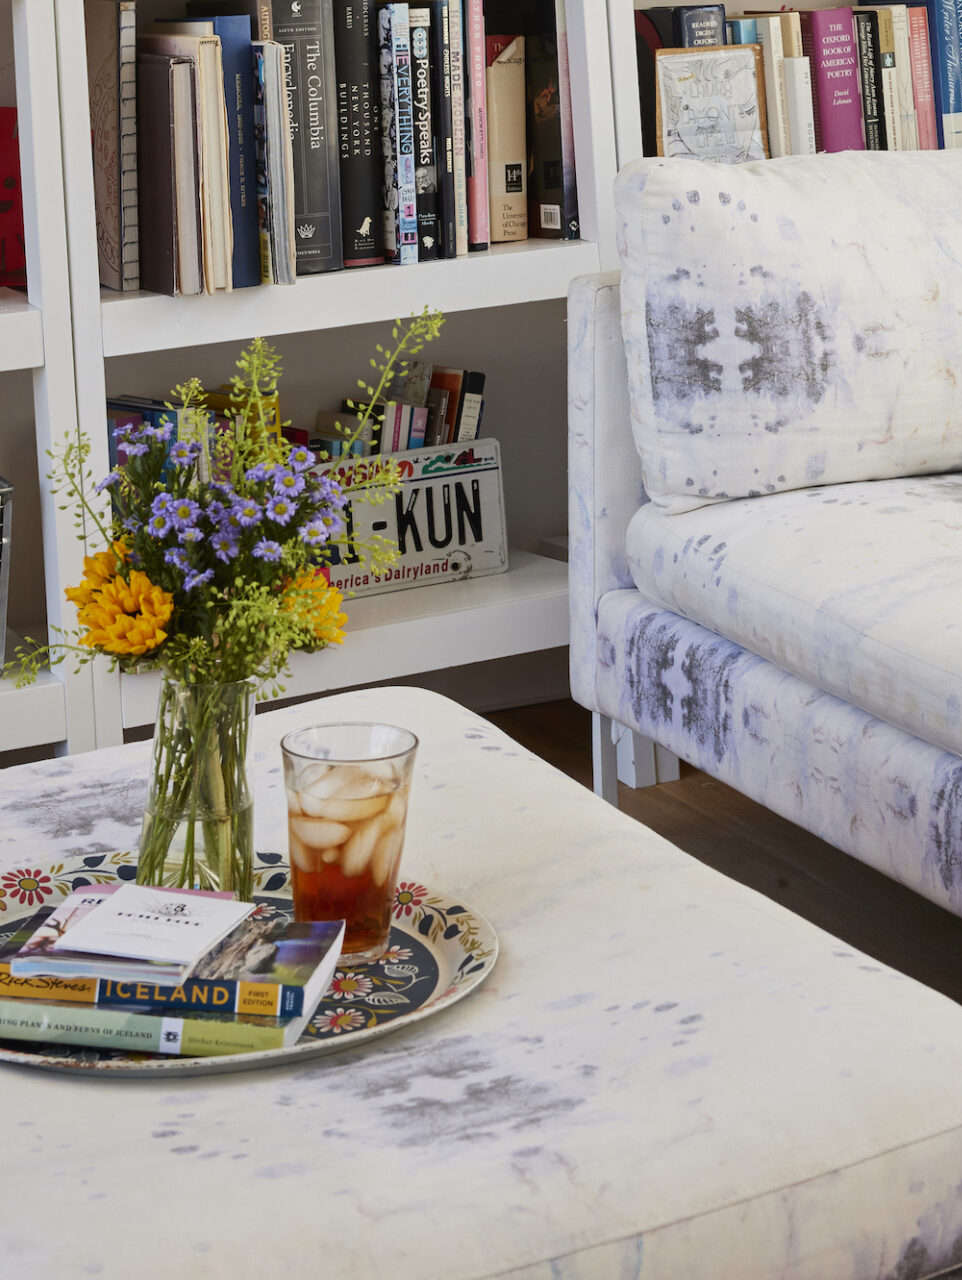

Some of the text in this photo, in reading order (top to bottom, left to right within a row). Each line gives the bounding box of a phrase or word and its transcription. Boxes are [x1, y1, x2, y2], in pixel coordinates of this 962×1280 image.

[828, 23, 843, 31] THE
[822, 34, 851, 44] OXFORD
[822, 45, 852, 56] BOOK OF
[474, 47, 482, 87] PHOTO
[821, 57, 855, 68] AMERICAN
[827, 69, 852, 79] POETRY
[943, 43, 959, 105] Thesaurus
[306, 41, 323, 149] The Columbia
[834, 89, 849, 97] David
[396, 55, 413, 154] EVERYTHING
[414, 58, 433, 164] Poetry Speaks
[340, 83, 349, 159] BUILDINGS
[362, 82, 371, 156] THOUSAND
[453, 95, 464, 156] MODERN
[507, 169, 522, 182] 14th
[329, 559, 449, 591] erica's Dairyland
[37, 975, 92, 993] Steves
[106, 981, 230, 1005] ICELAND
[248, 989, 270, 1000] FIRST
[243, 998, 275, 1008] EDITION
[20, 1019, 52, 1031] PLANS
[53, 1023, 72, 1034] AND
[74, 1024, 101, 1036] FERNS
[103, 1028, 114, 1037] OF
[116, 1028, 153, 1040] ICELAND
